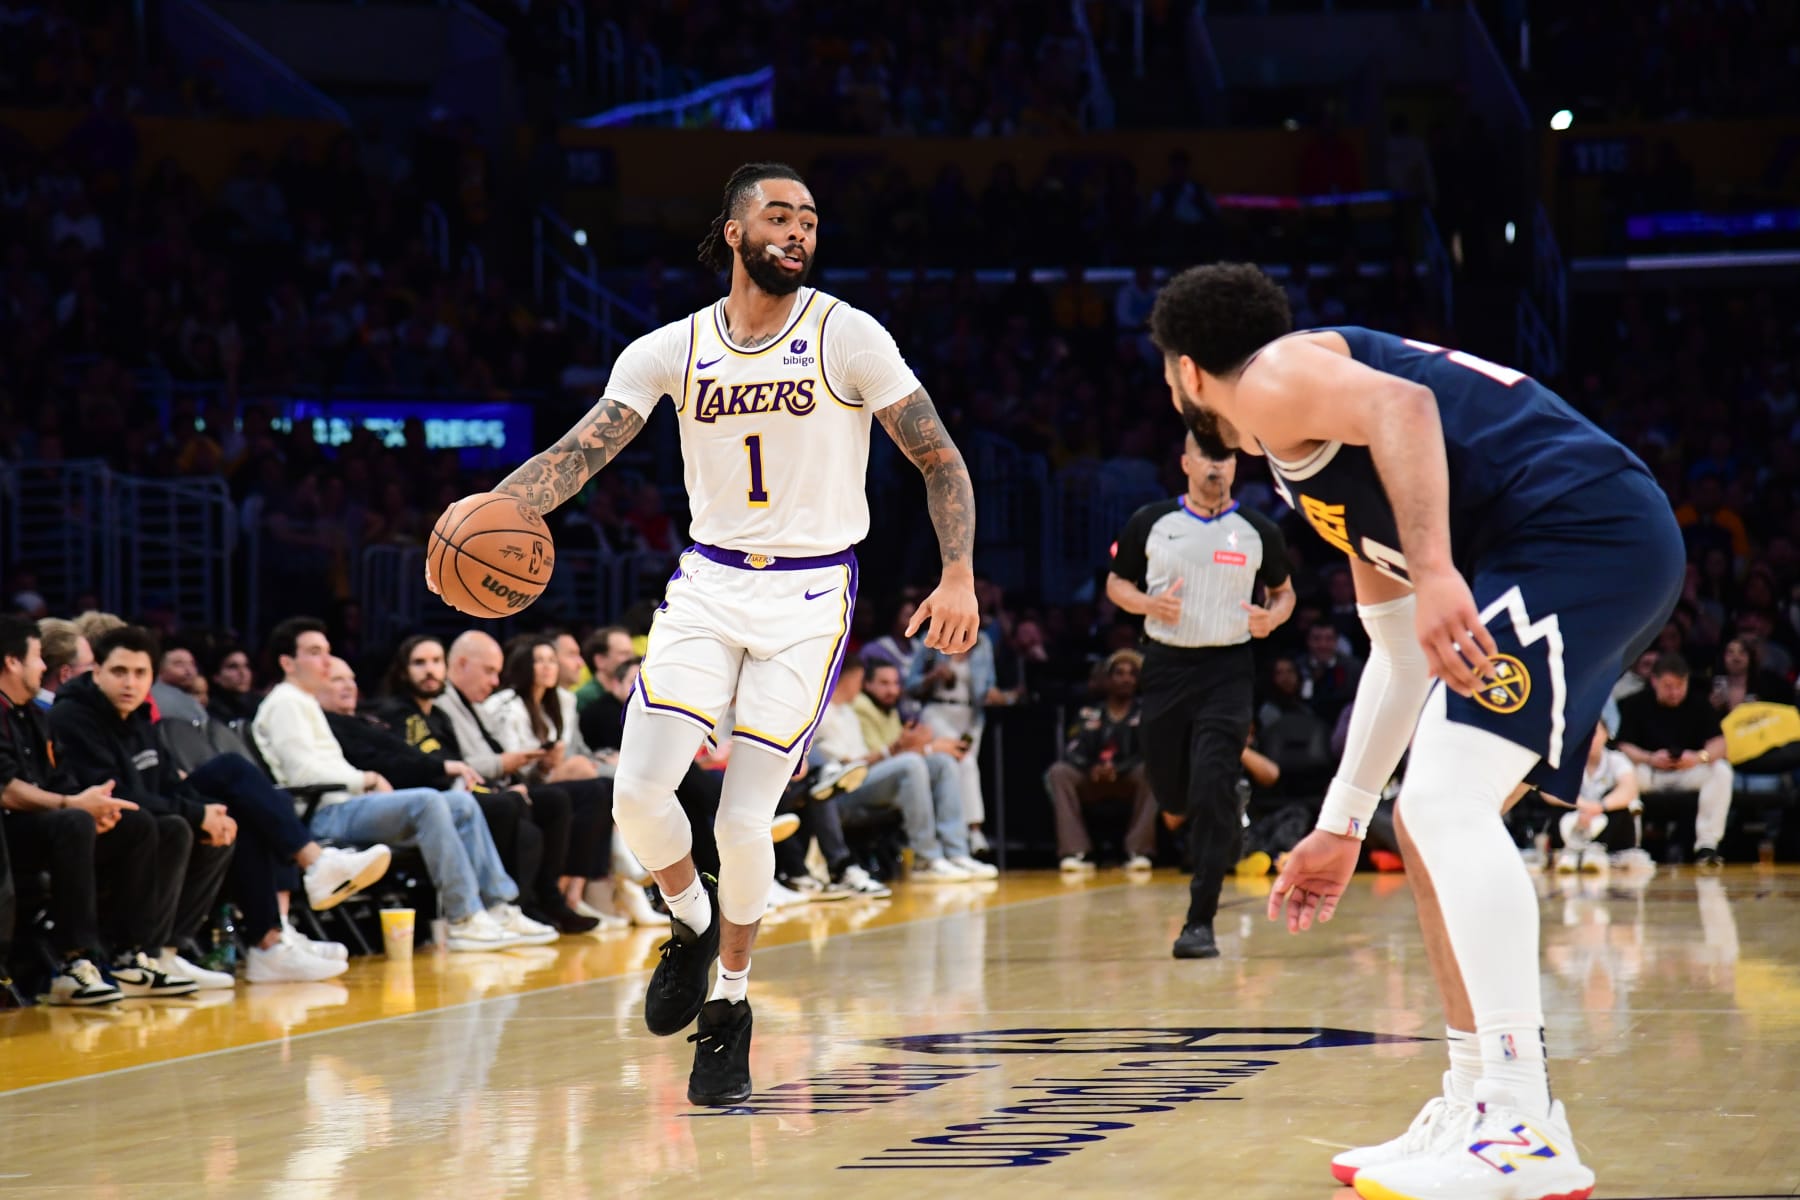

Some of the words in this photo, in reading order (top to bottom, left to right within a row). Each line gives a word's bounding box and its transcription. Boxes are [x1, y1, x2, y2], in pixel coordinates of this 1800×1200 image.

[783, 354, 815, 367] bibigo
[694, 378, 817, 424] LAKERS
[744, 432, 770, 508] 1
